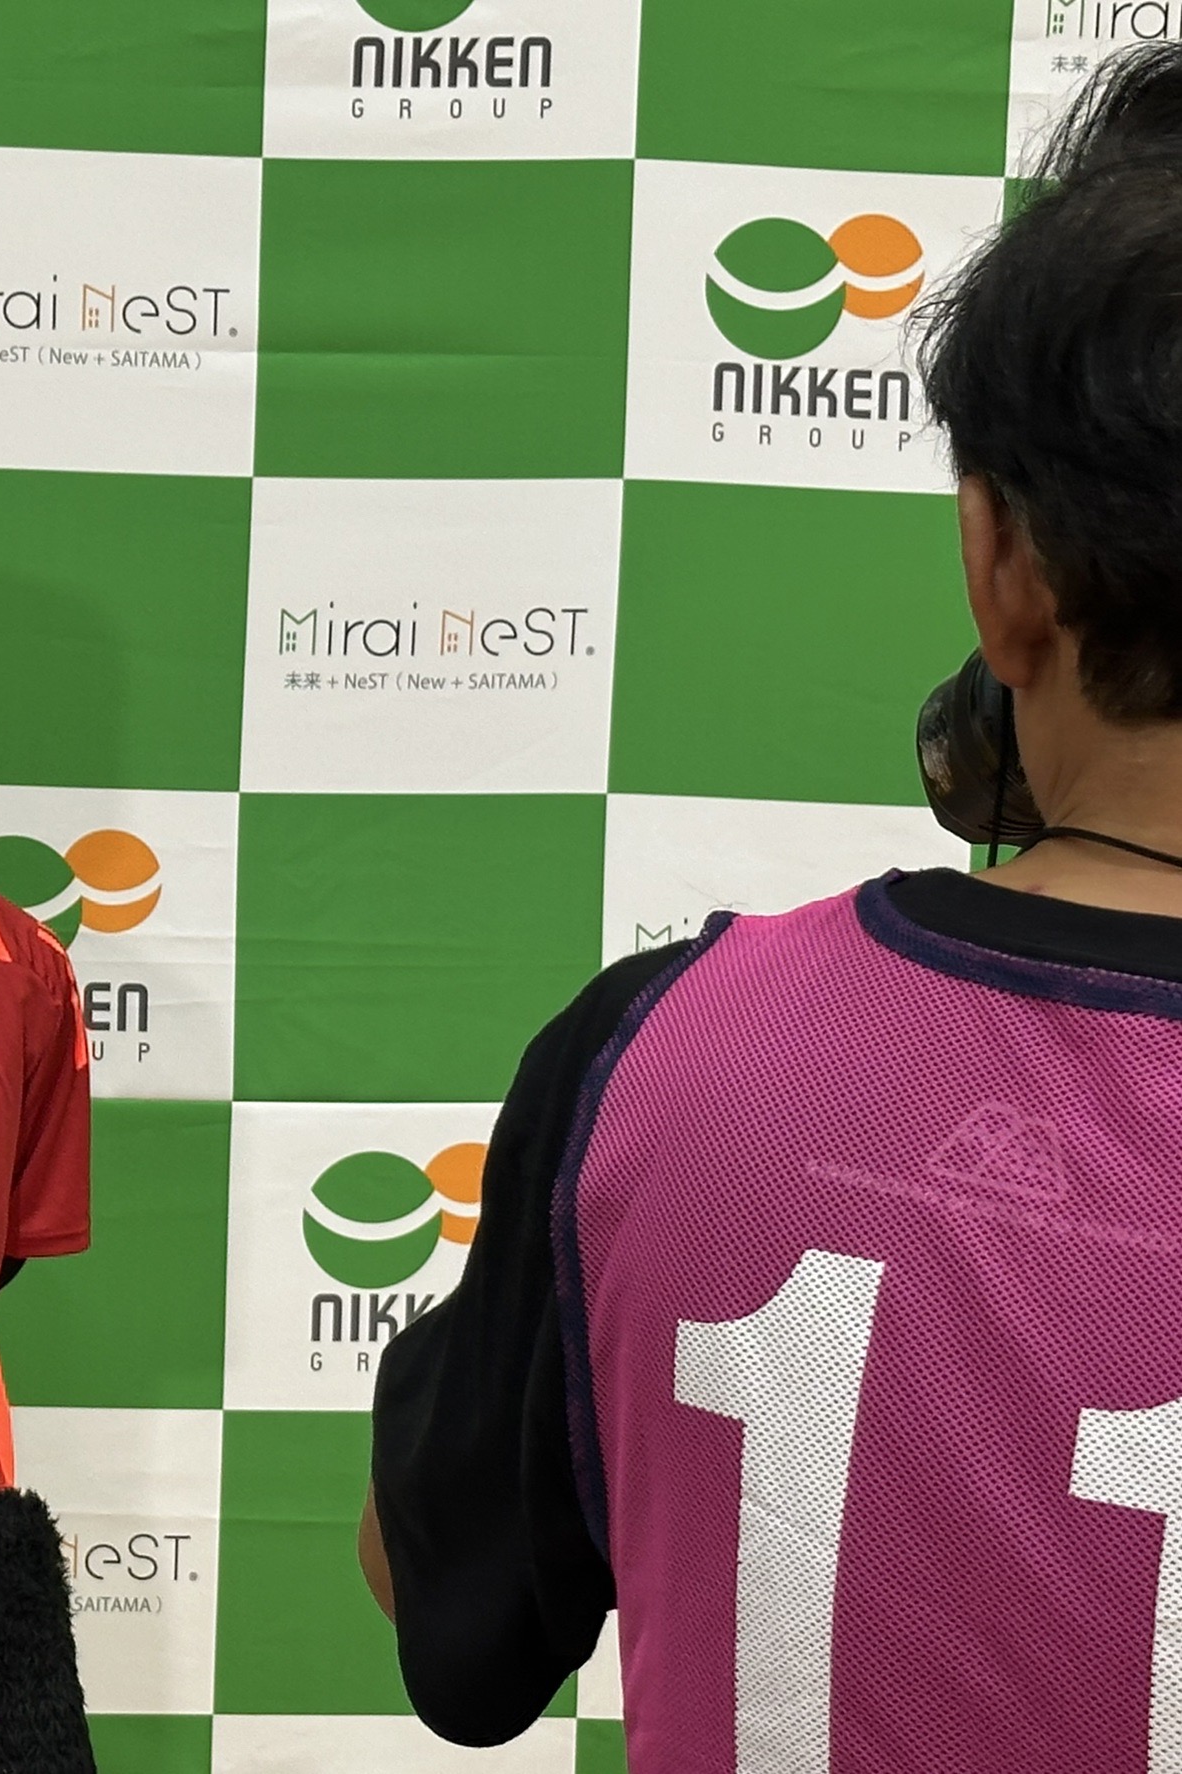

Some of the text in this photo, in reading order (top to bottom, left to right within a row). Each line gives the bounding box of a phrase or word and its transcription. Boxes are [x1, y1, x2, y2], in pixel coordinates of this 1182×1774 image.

[352, 37, 552, 88] NIKKEN
[351, 97, 553, 119] GROUP
[713, 362, 910, 422] NIKKEN
[712, 422, 911, 451] GROUP
[279, 601, 418, 657] Mirai
[343, 672, 389, 691] NeST
[311, 1293, 435, 1342] NIKK
